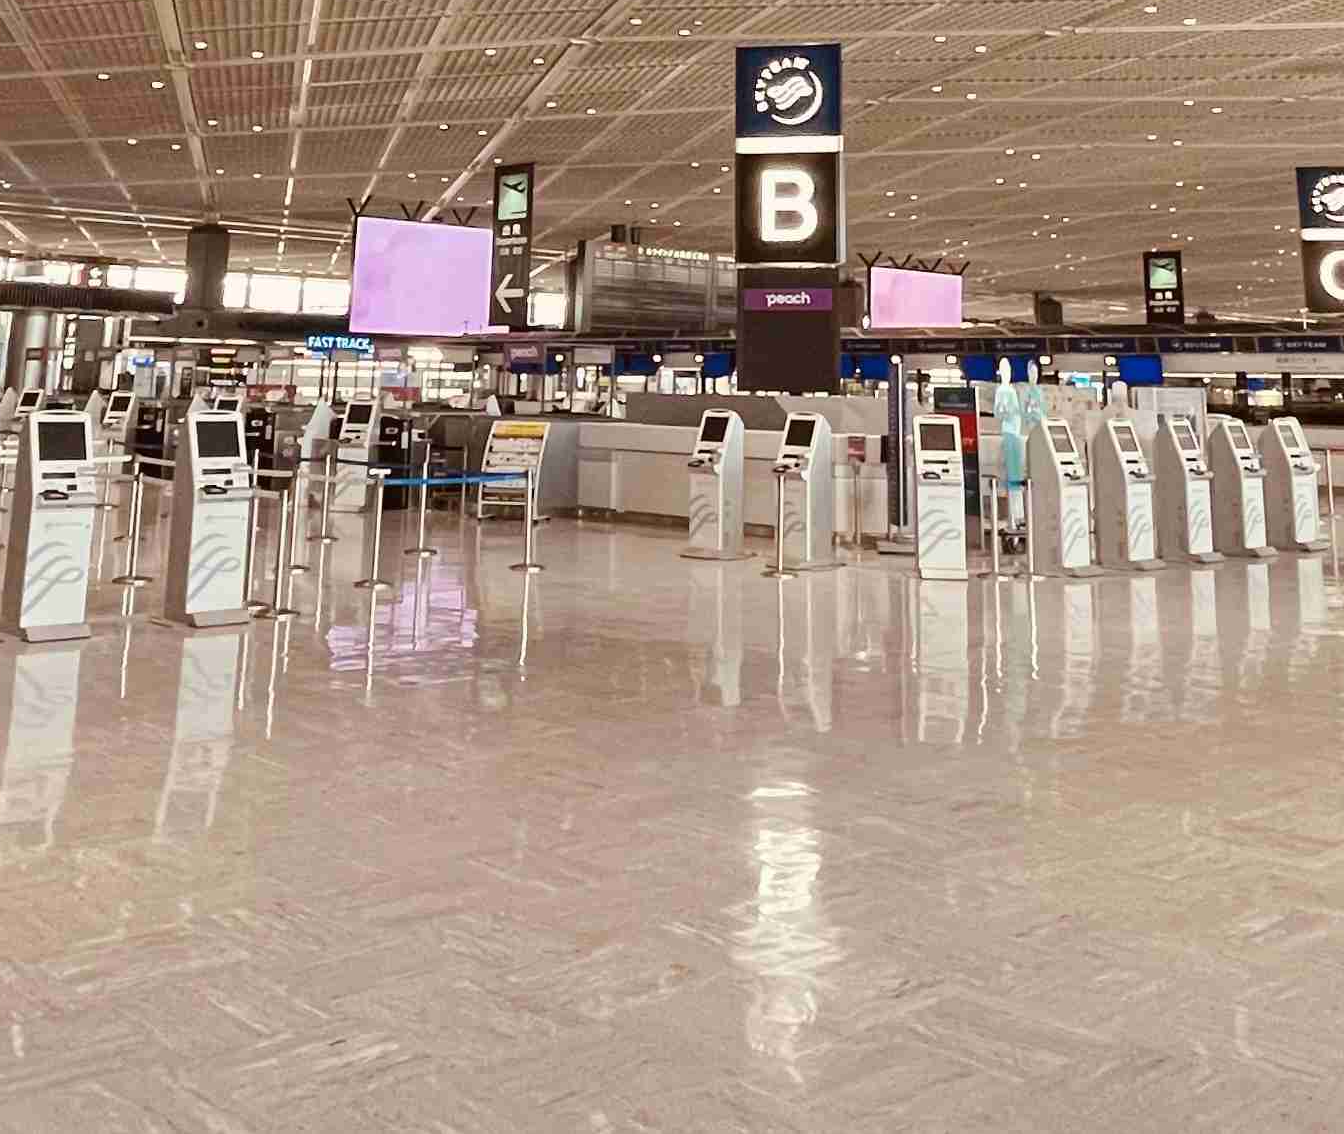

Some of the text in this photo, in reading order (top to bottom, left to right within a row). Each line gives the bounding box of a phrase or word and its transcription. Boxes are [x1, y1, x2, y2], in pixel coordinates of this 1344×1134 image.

[761, 169, 818, 242] B
[766, 291, 811, 307] peach
[308, 336, 334, 348] FAST
